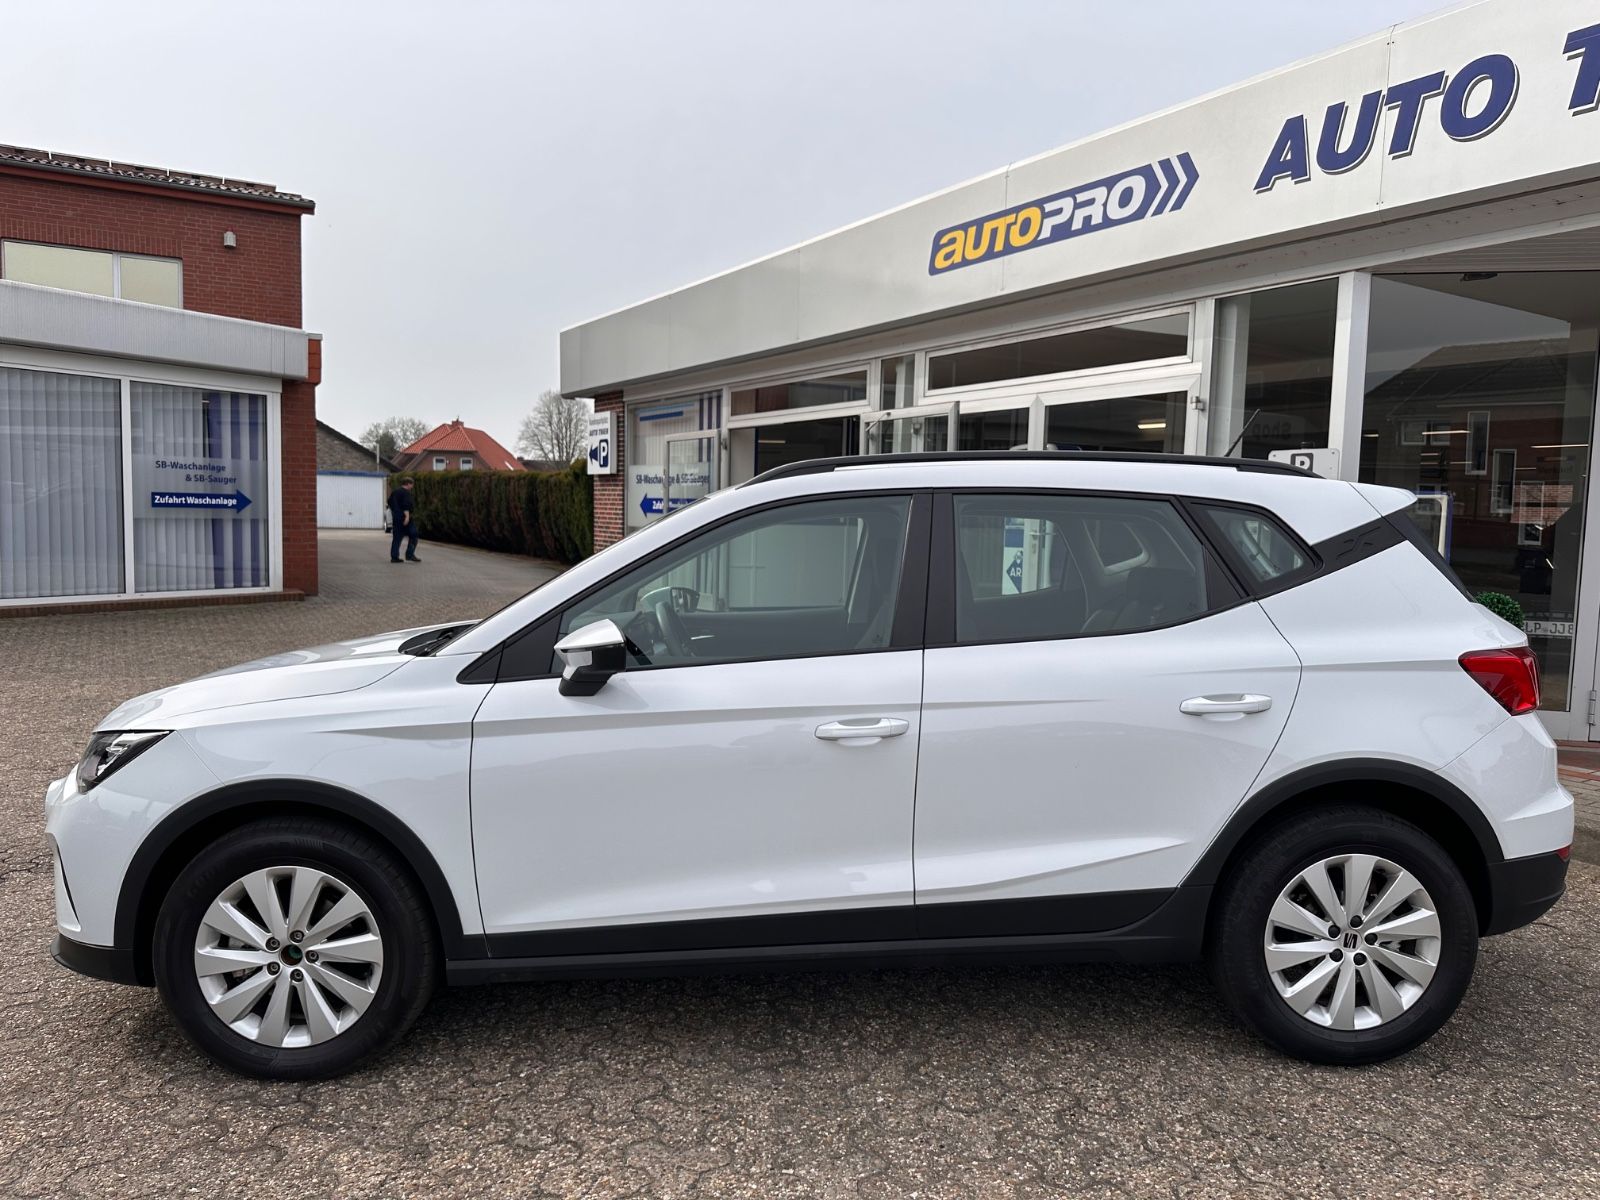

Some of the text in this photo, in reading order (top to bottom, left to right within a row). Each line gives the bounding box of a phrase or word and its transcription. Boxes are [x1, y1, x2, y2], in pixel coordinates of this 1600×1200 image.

[1253, 53, 1520, 194] AUTO
[600, 441, 608, 465] P
[155, 461, 226, 473] SB-Waschanlage
[185, 474, 237, 485] & SB-Sauger
[154, 495, 237, 506] Zufahrt Waschanlage
[1010, 567, 1021, 577] AR
[1525, 621, 1574, 635] LP JJ8
